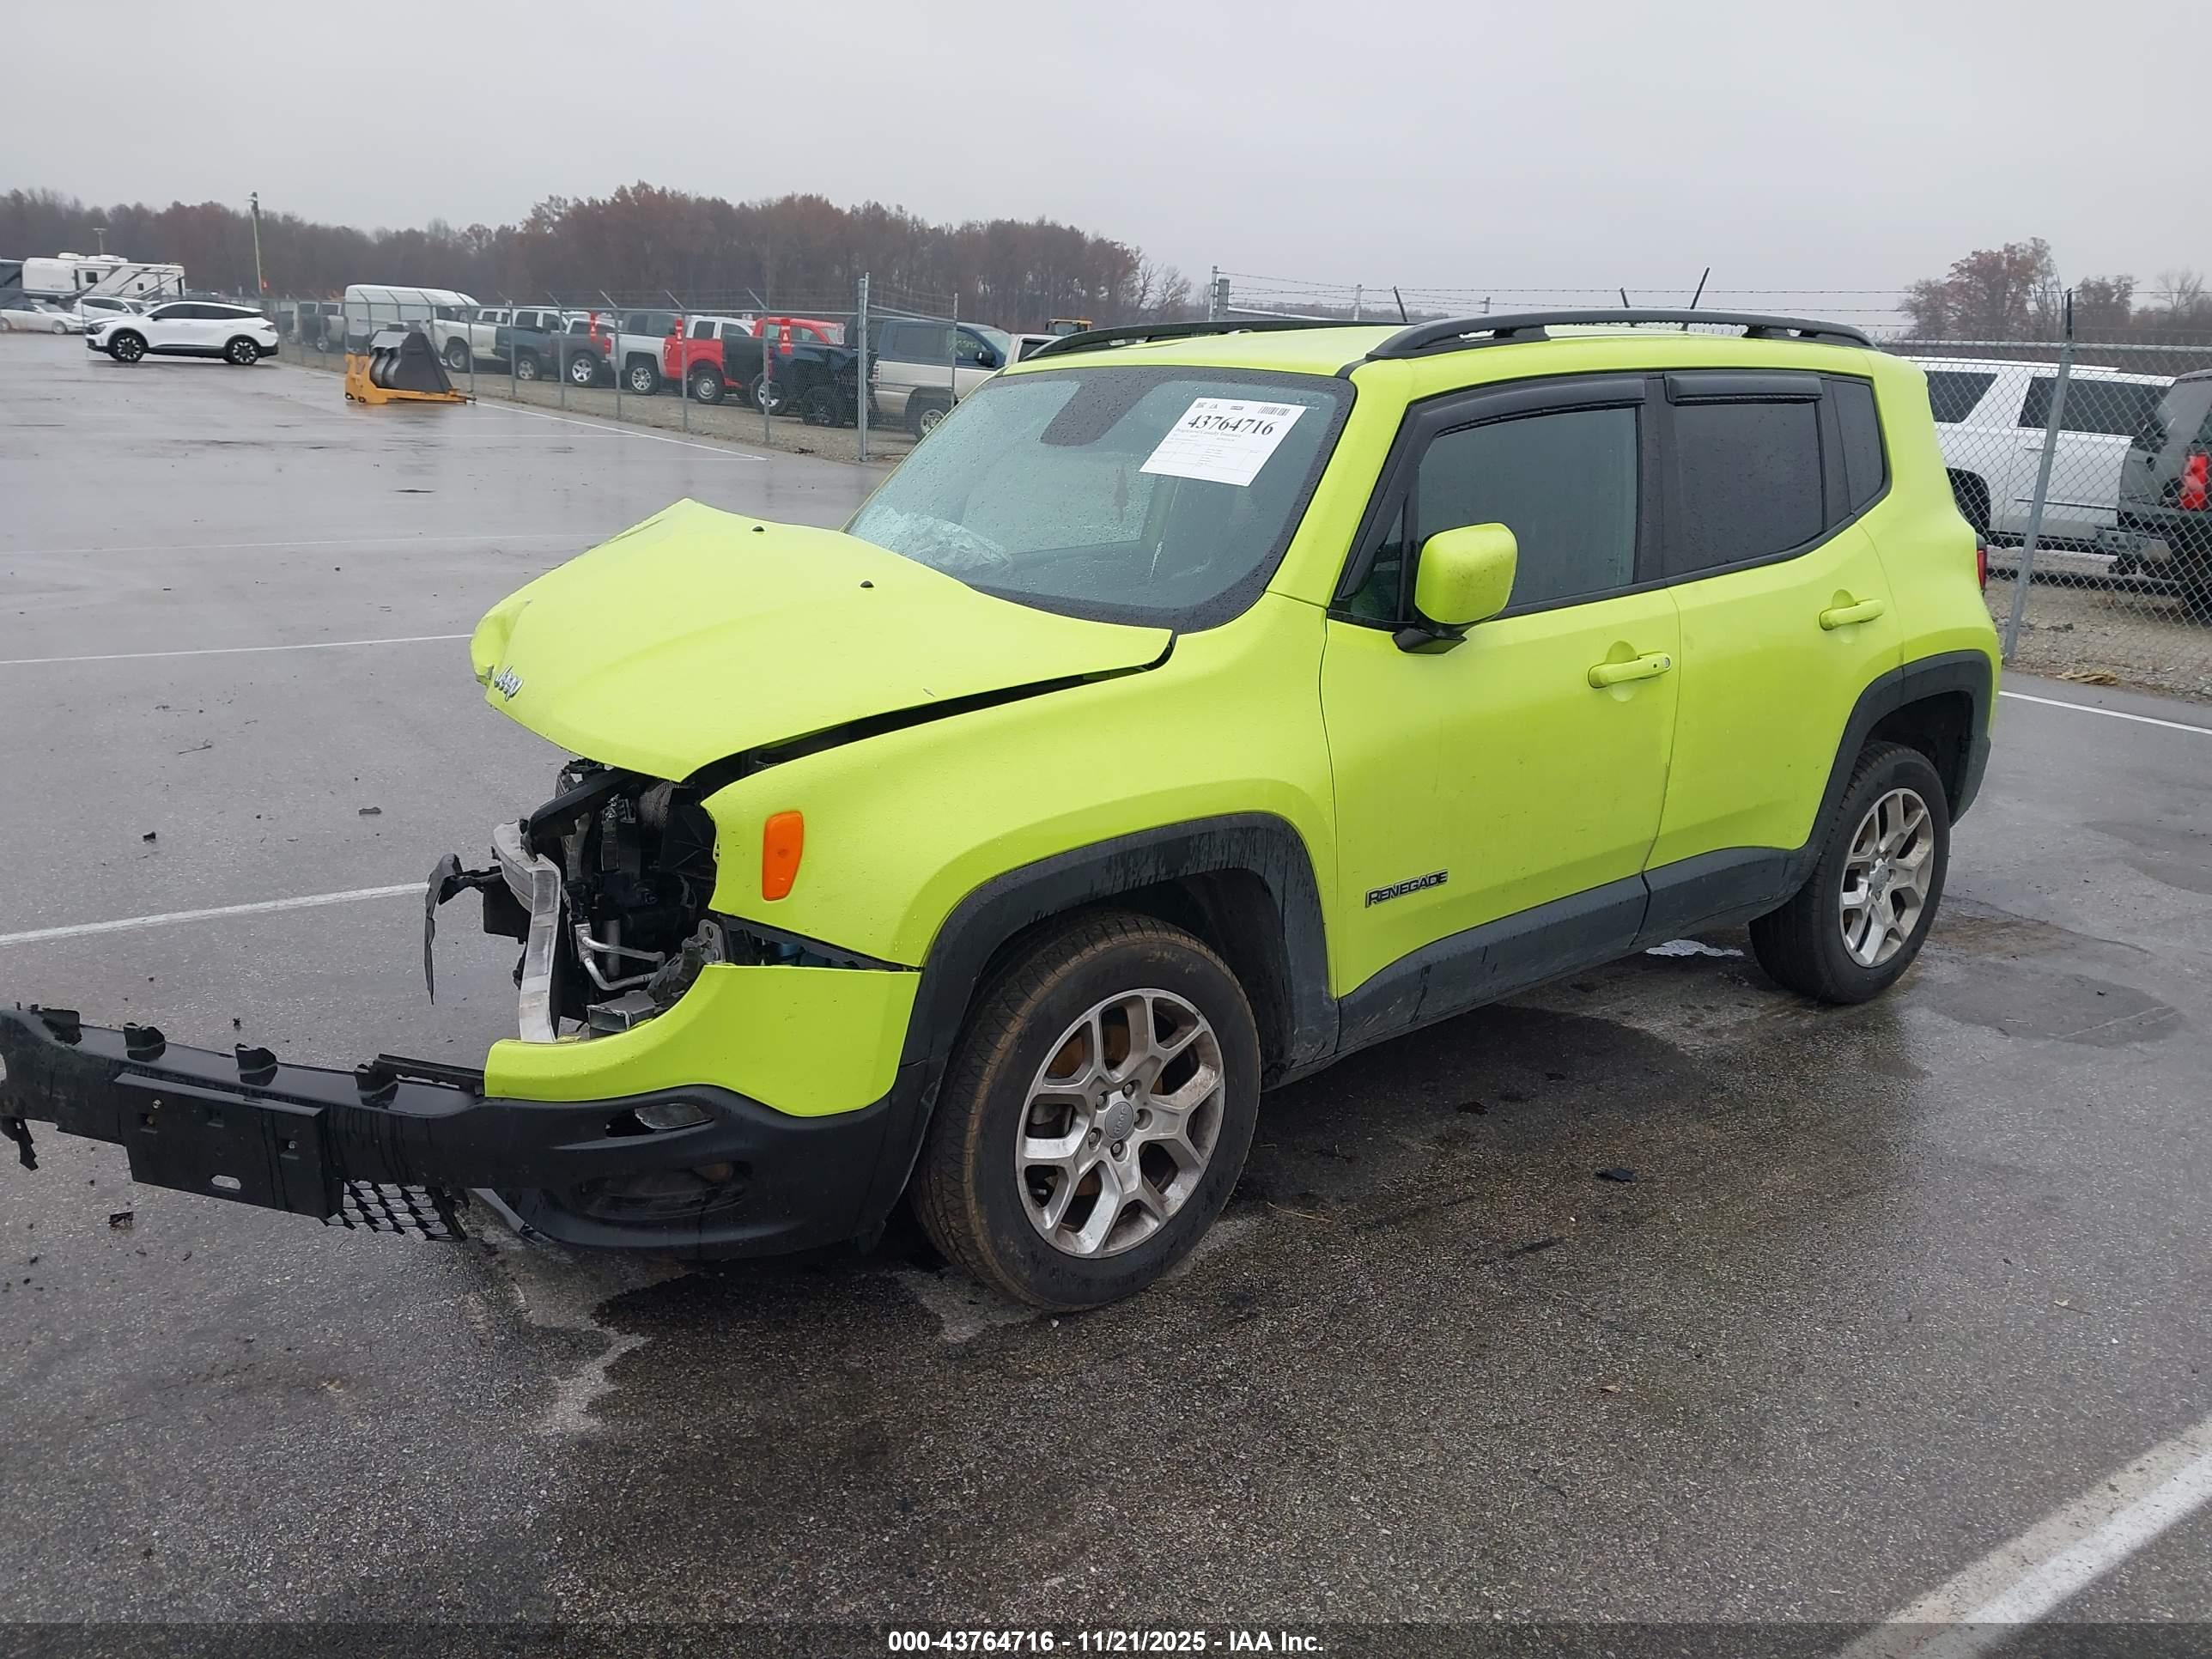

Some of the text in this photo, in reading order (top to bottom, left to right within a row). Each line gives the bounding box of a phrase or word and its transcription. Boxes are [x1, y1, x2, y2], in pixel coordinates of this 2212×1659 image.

[1188, 415, 1279, 436] 43764716
[494, 665, 524, 702] Jeep
[1365, 869, 1449, 908] RENEGADE
